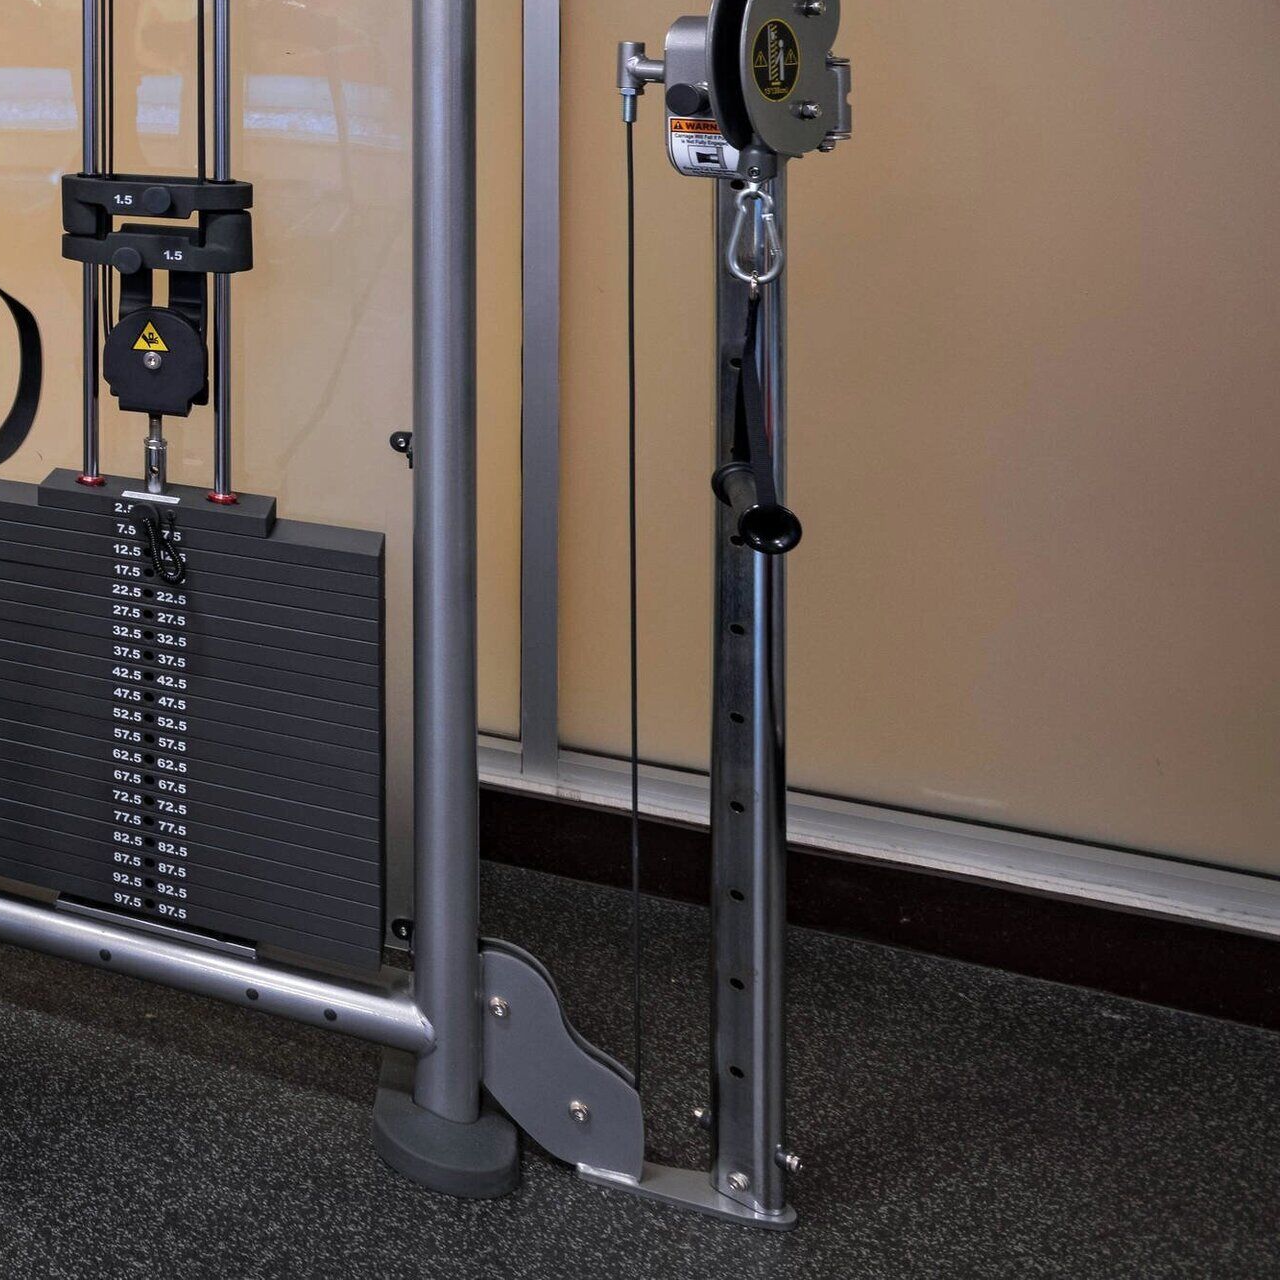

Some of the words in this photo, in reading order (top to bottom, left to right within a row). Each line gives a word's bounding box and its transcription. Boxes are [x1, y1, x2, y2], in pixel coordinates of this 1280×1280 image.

[686, 122, 718, 130] WARN
[114, 195, 132, 204] 1.5
[164, 251, 182, 260] 1.5
[117, 524, 136, 534] 7.5
[113, 544, 141, 556] 12.5
[115, 565, 140, 576] 17.5
[113, 584, 141, 597] 22.5
[157, 592, 186, 604] 22.5
[113, 605, 140, 618] 27.5
[158, 613, 185, 625] 27.5
[113, 626, 141, 638] 32.5
[158, 634, 186, 646] 32.5
[114, 646, 140, 659] 37.5
[158, 654, 185, 667] 37.5
[113, 667, 141, 680] 42.5
[157, 676, 186, 688] 42.5
[114, 688, 140, 700] 47.5
[159, 697, 185, 709] 47.5
[114, 708, 141, 721] 52.5
[158, 717, 186, 730] 52.5
[115, 728, 140, 741] 57.5
[159, 738, 185, 751] 57.5
[113, 749, 141, 762] 62.5
[158, 759, 186, 772] 62.5
[114, 770, 141, 783] 67.5
[159, 780, 186, 793] 67.5
[113, 790, 141, 804] 72.5
[158, 800, 186, 814] 72.5
[114, 811, 141, 824] 77.5
[159, 821, 186, 835] 77.5
[114, 832, 142, 845] 82.5
[158, 842, 187, 856] 82.5
[114, 852, 140, 866] 87.5
[159, 863, 186, 877] 87.5
[113, 872, 141, 886] 92.5
[158, 883, 186, 898] 92.5
[114, 893, 141, 907] 97.5
[159, 904, 186, 918] 97.5
